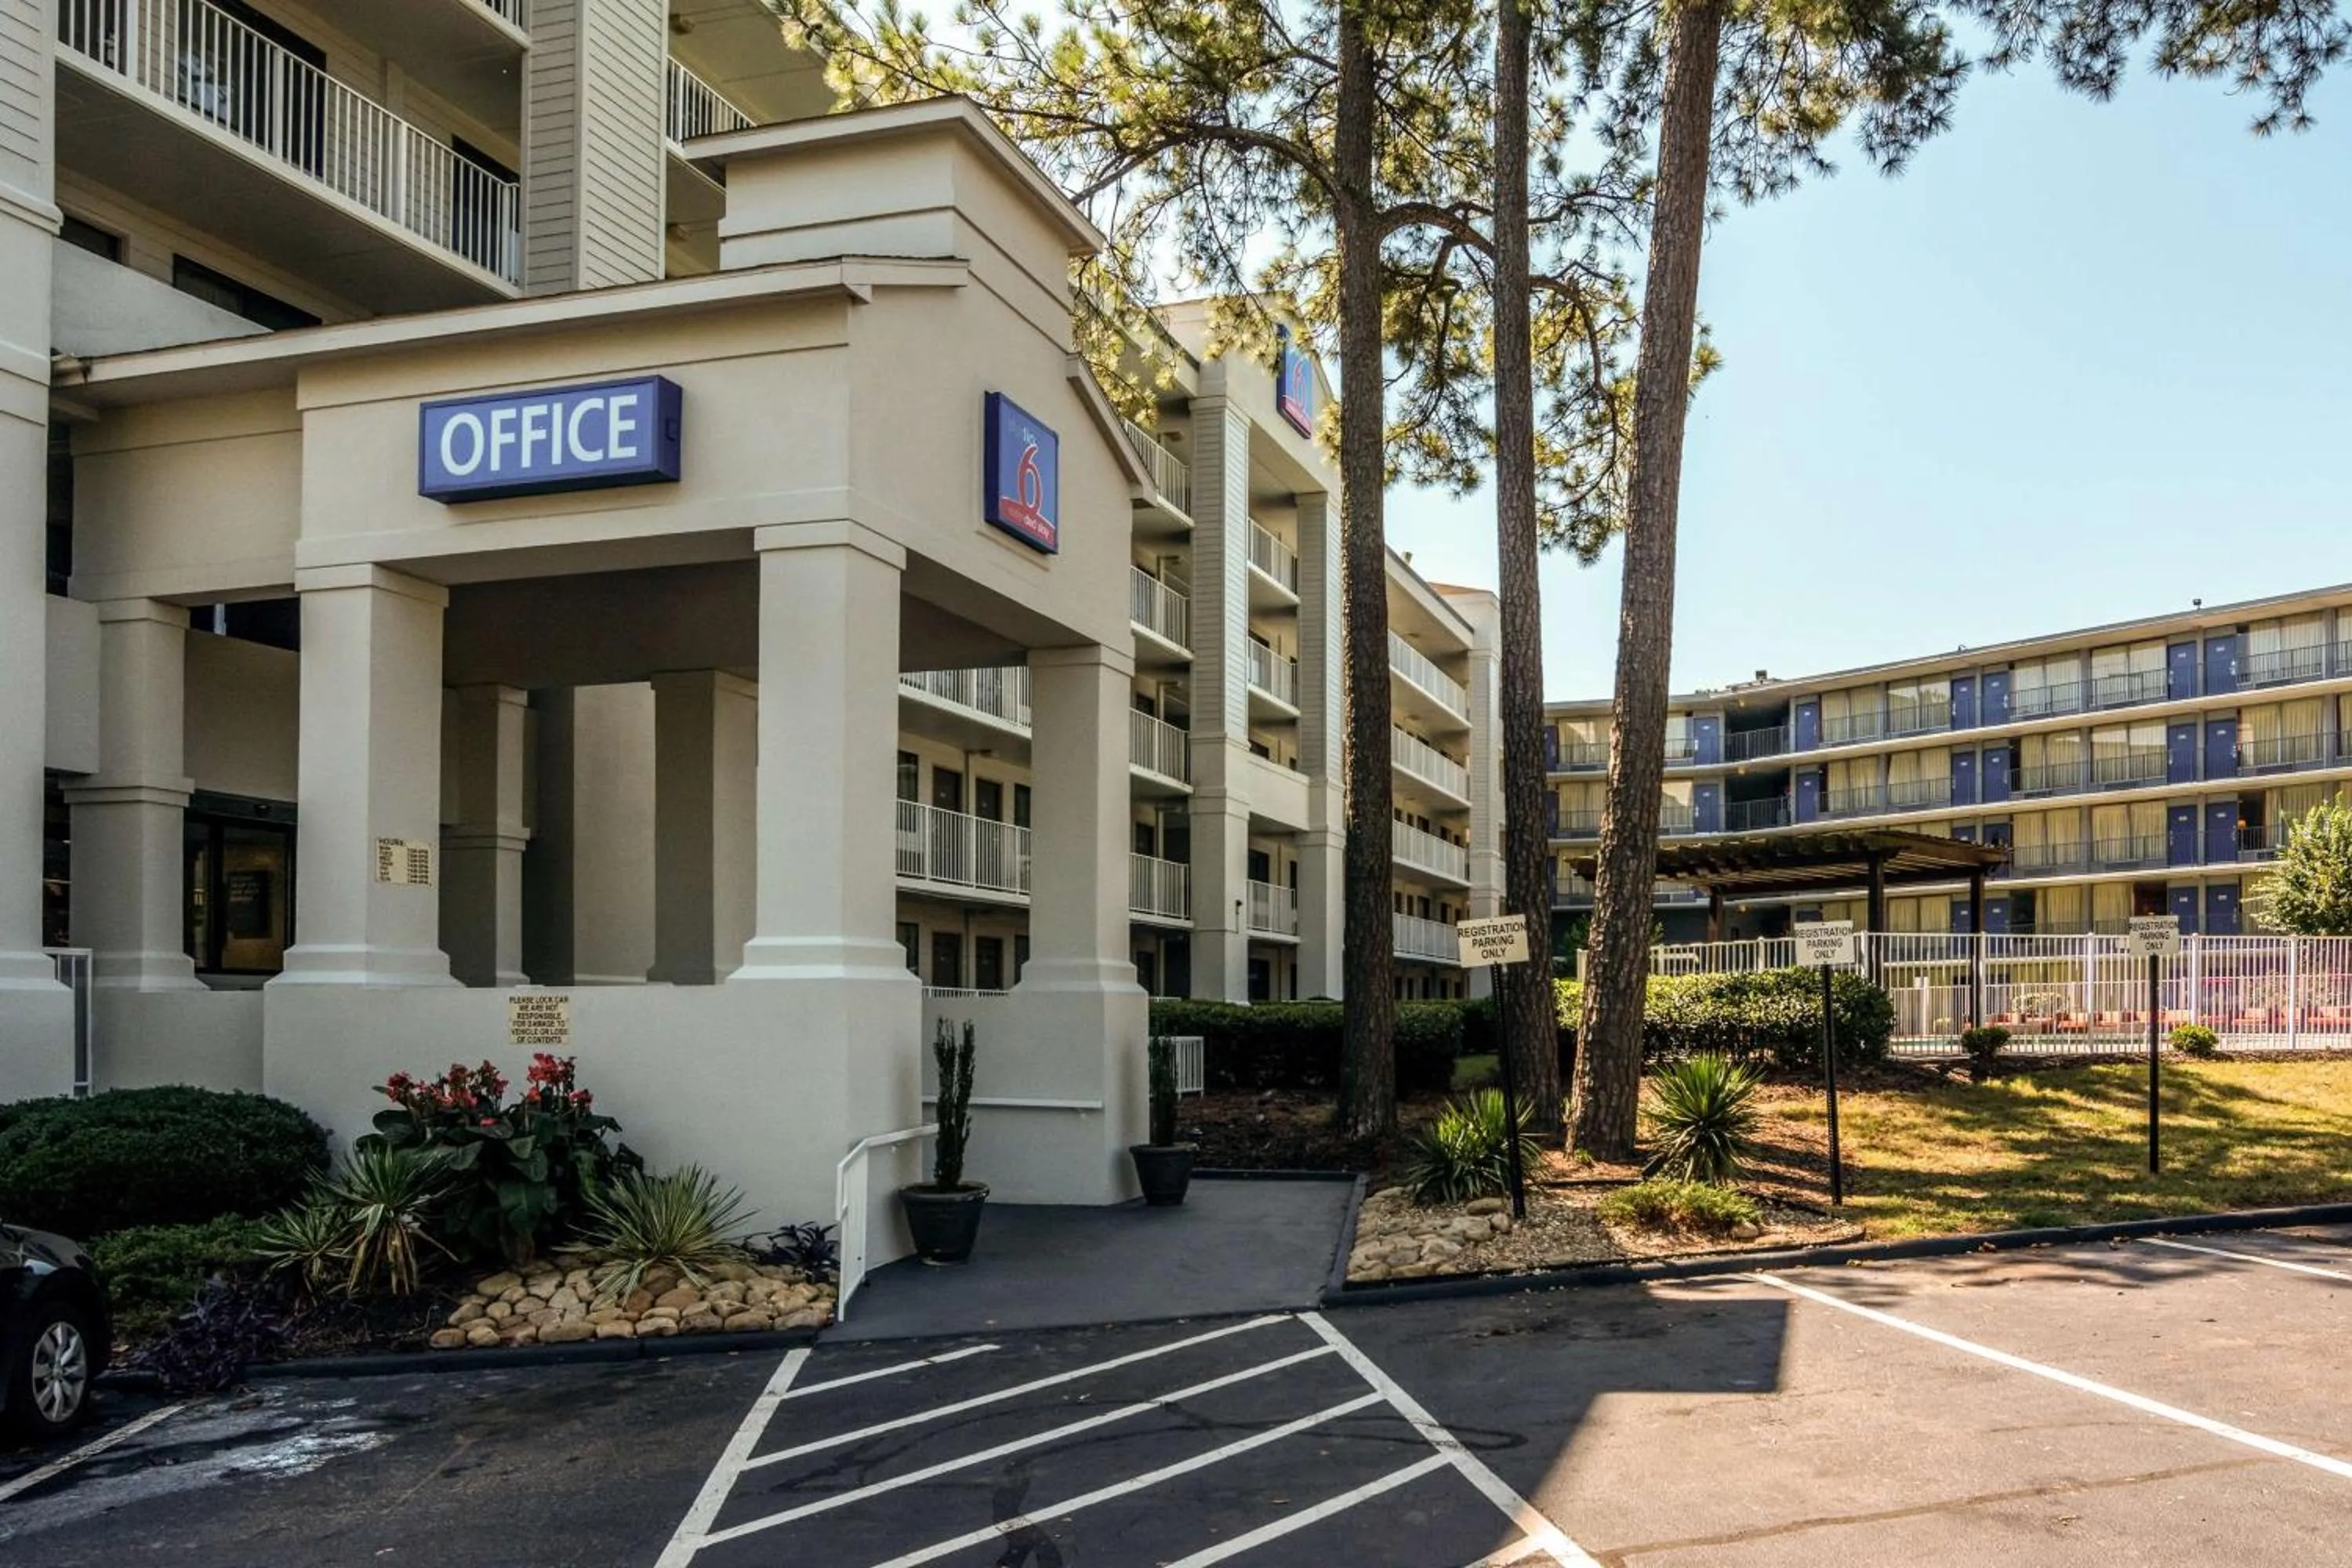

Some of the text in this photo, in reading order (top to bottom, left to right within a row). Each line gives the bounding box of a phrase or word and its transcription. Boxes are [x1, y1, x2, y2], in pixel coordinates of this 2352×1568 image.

[441, 394, 637, 476] OFFICE
[1018, 443, 1044, 514] 6
[1457, 922, 1526, 938] REGISTRATION
[1472, 935, 1514, 948] PARKING
[1806, 938, 1842, 949] PARKING
[2145, 942, 2163, 950] ONLY
[1481, 947, 1505, 959] ONLY
[1813, 949, 1836, 959] ONLY
[509, 996, 534, 1004] PLEASE
